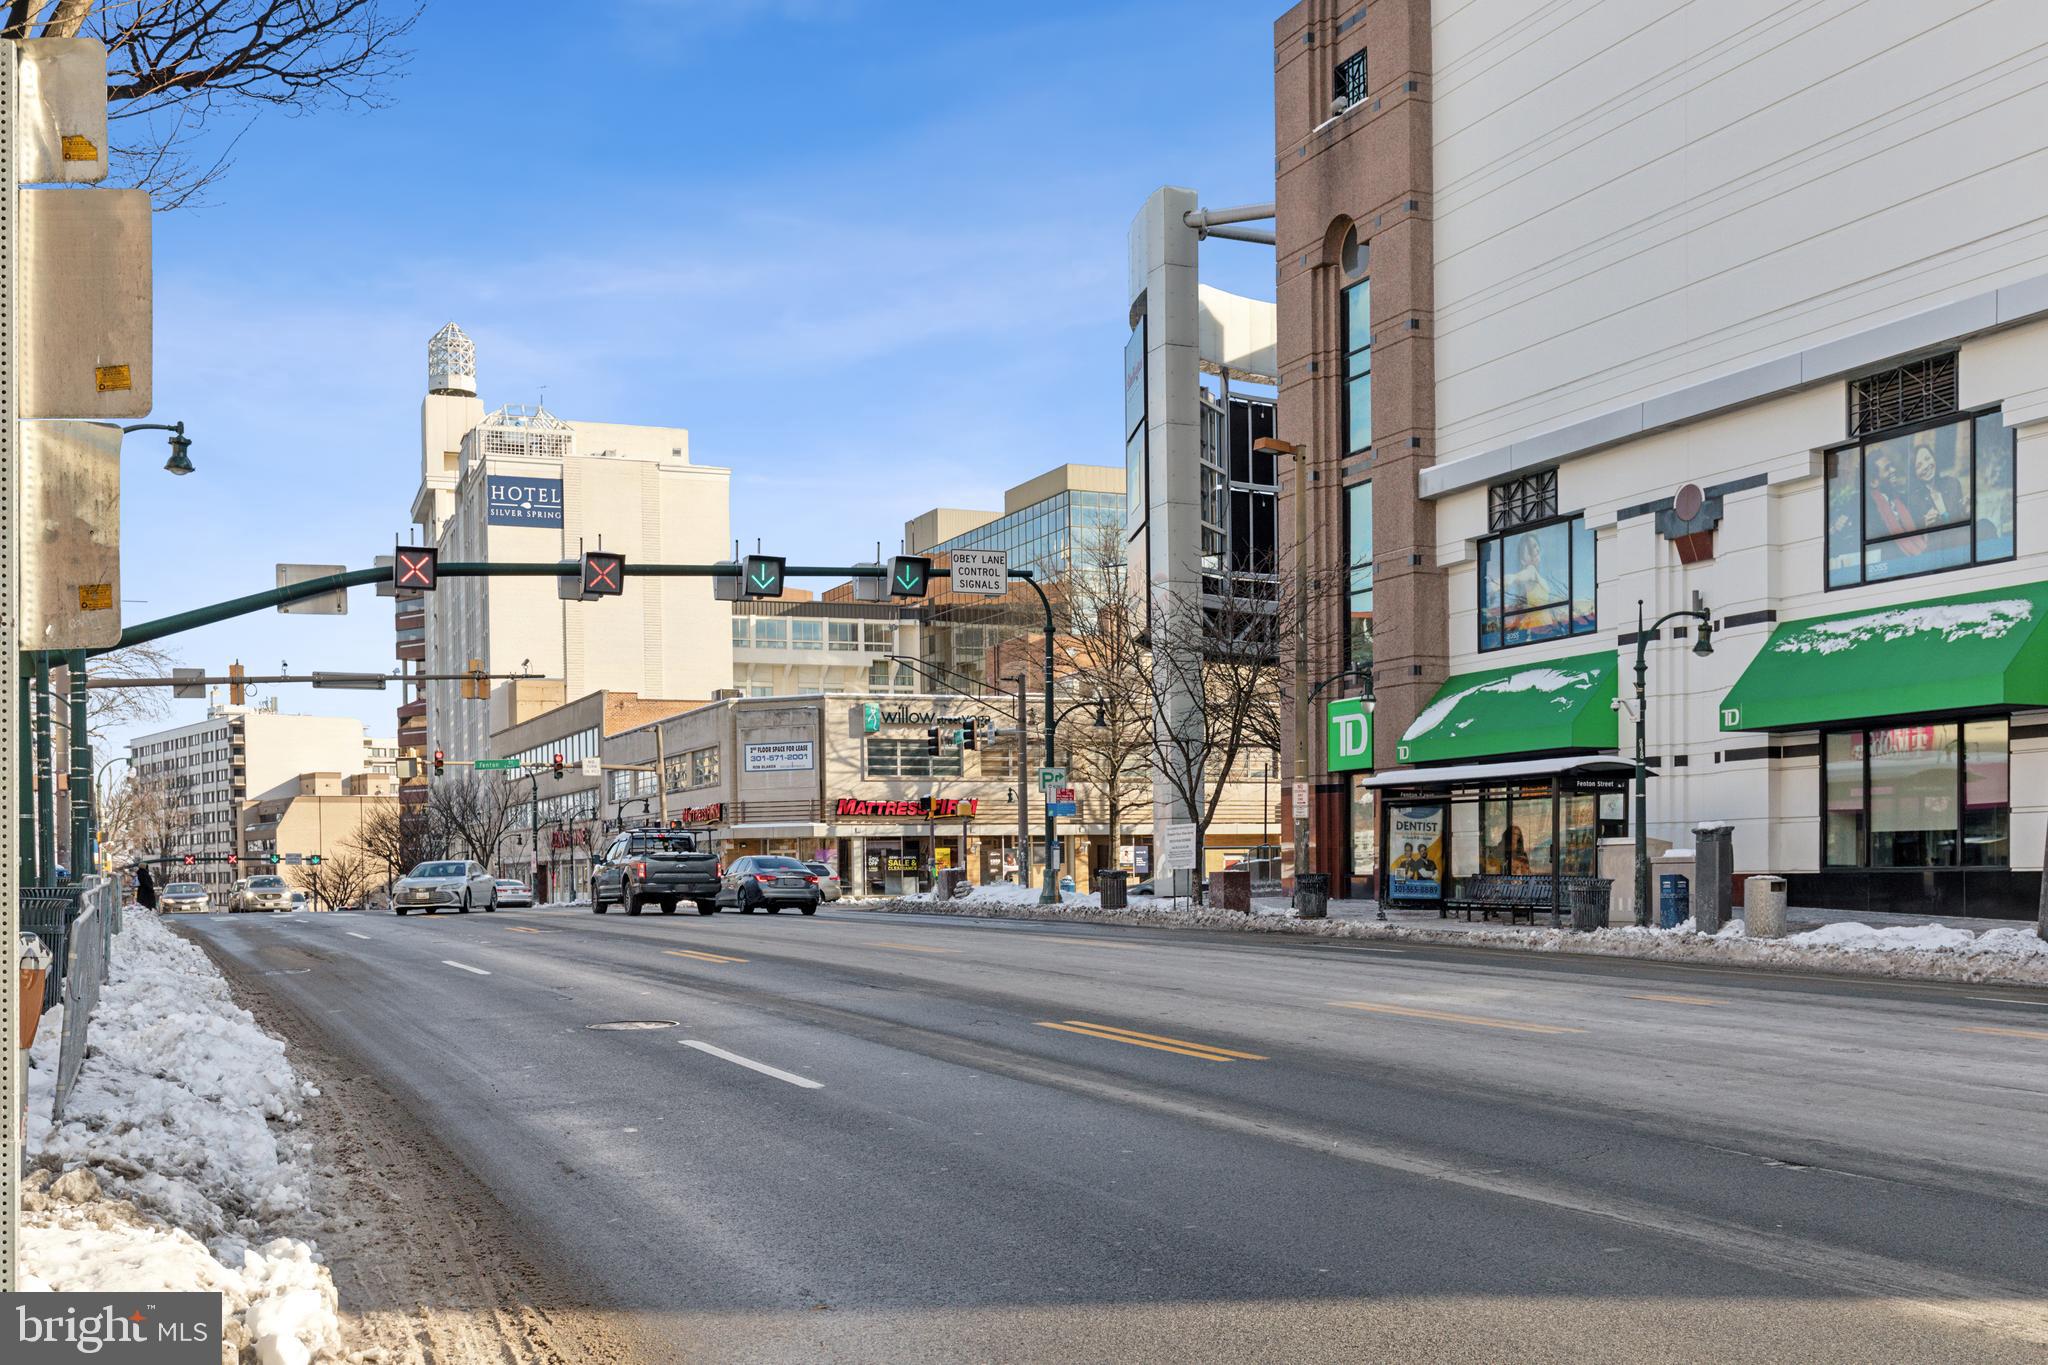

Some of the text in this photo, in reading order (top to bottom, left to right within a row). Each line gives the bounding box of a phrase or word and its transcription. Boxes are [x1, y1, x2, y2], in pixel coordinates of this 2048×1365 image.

[491, 486, 560, 503] HOTEL
[490, 508, 562, 519] SILVER SPRING
[953, 554, 1005, 565] OBEY LANE
[958, 567, 1000, 577] CONTROL
[959, 579, 1000, 590] SIGNALS
[881, 703, 936, 724] willow
[1721, 708, 1740, 726] TD
[1332, 713, 1368, 757] TD
[772, 745, 786, 753] SPACE
[795, 744, 809, 752] LEASE
[1396, 745, 1409, 760] TD
[750, 753, 809, 762] 301-571-2001
[1042, 772, 1055, 789] P
[1597, 780, 1614, 788] Street
[1396, 820, 1438, 832] DENTIST
